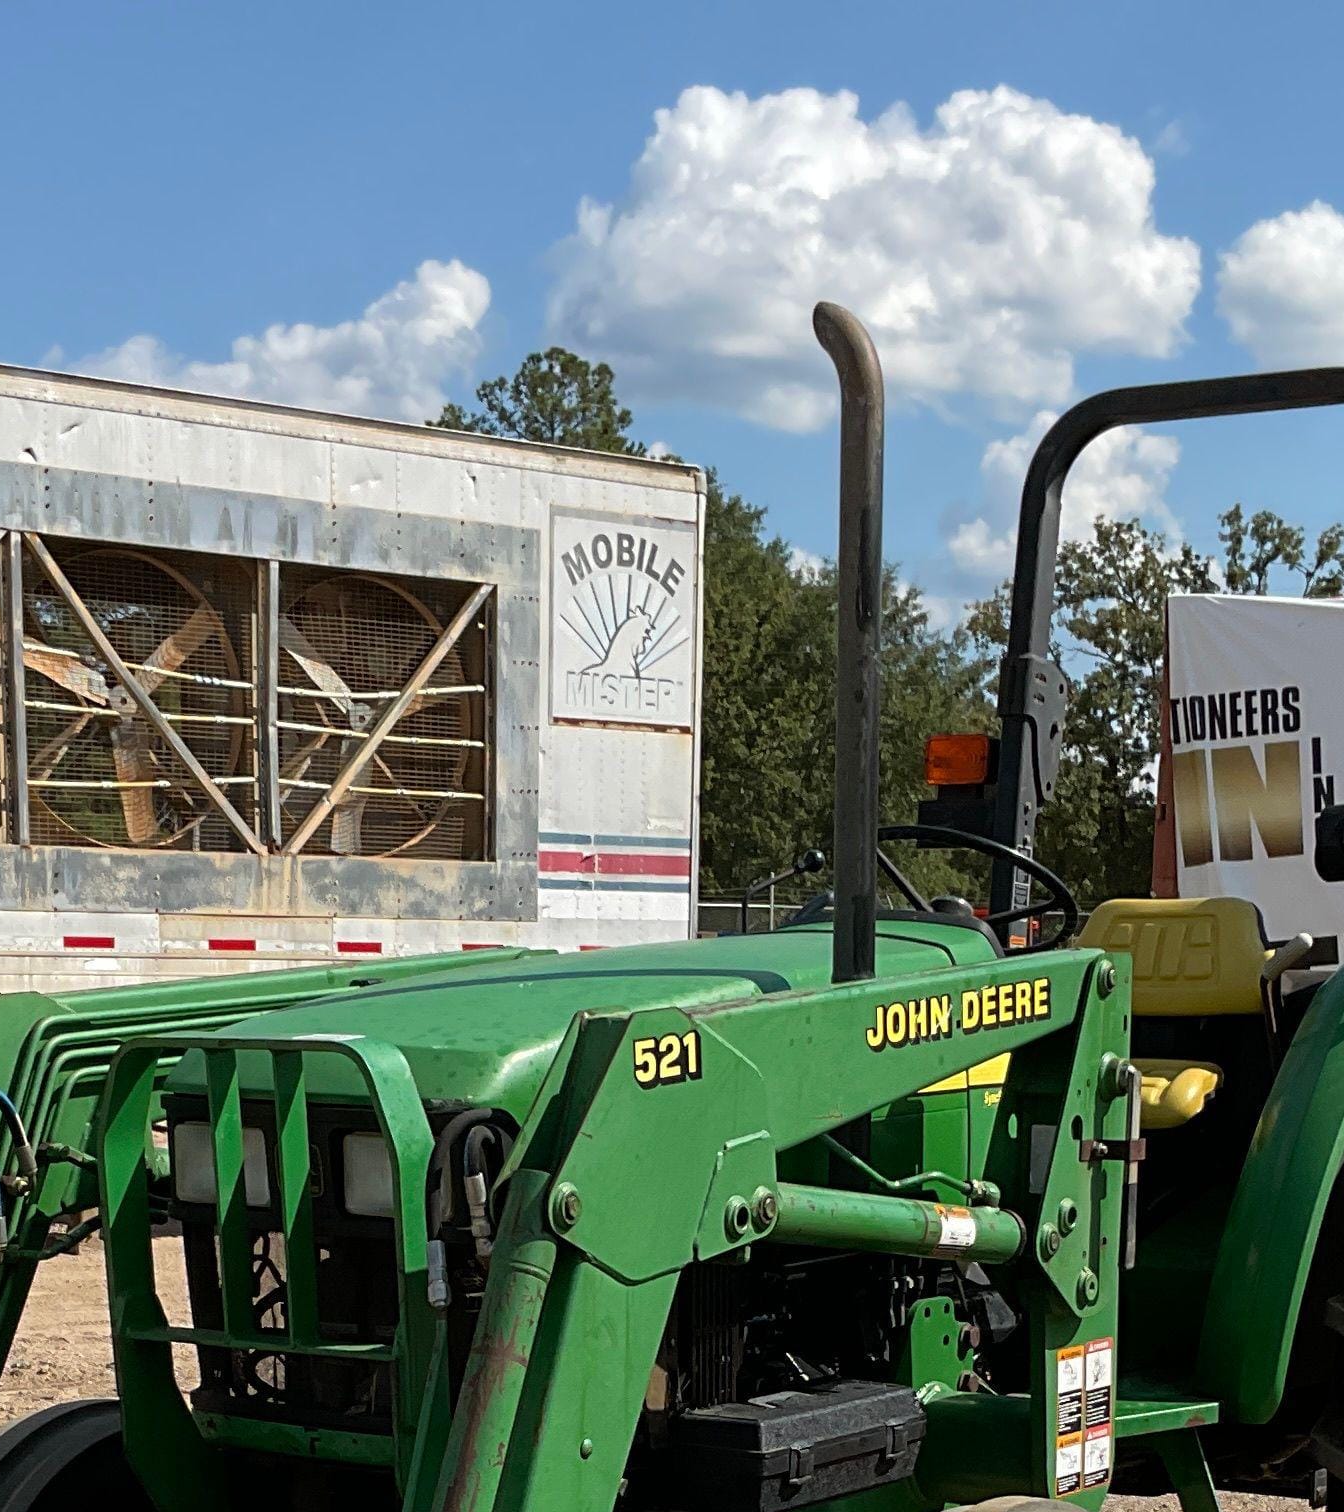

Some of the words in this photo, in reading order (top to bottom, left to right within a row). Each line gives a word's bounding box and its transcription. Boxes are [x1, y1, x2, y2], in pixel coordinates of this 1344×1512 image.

[561, 532, 686, 598] MOBILE
[566, 670, 675, 713] MISTER
[866, 993, 952, 1051] JOHN
[961, 977, 1052, 1034] DEERE
[633, 1030, 701, 1088] 521
